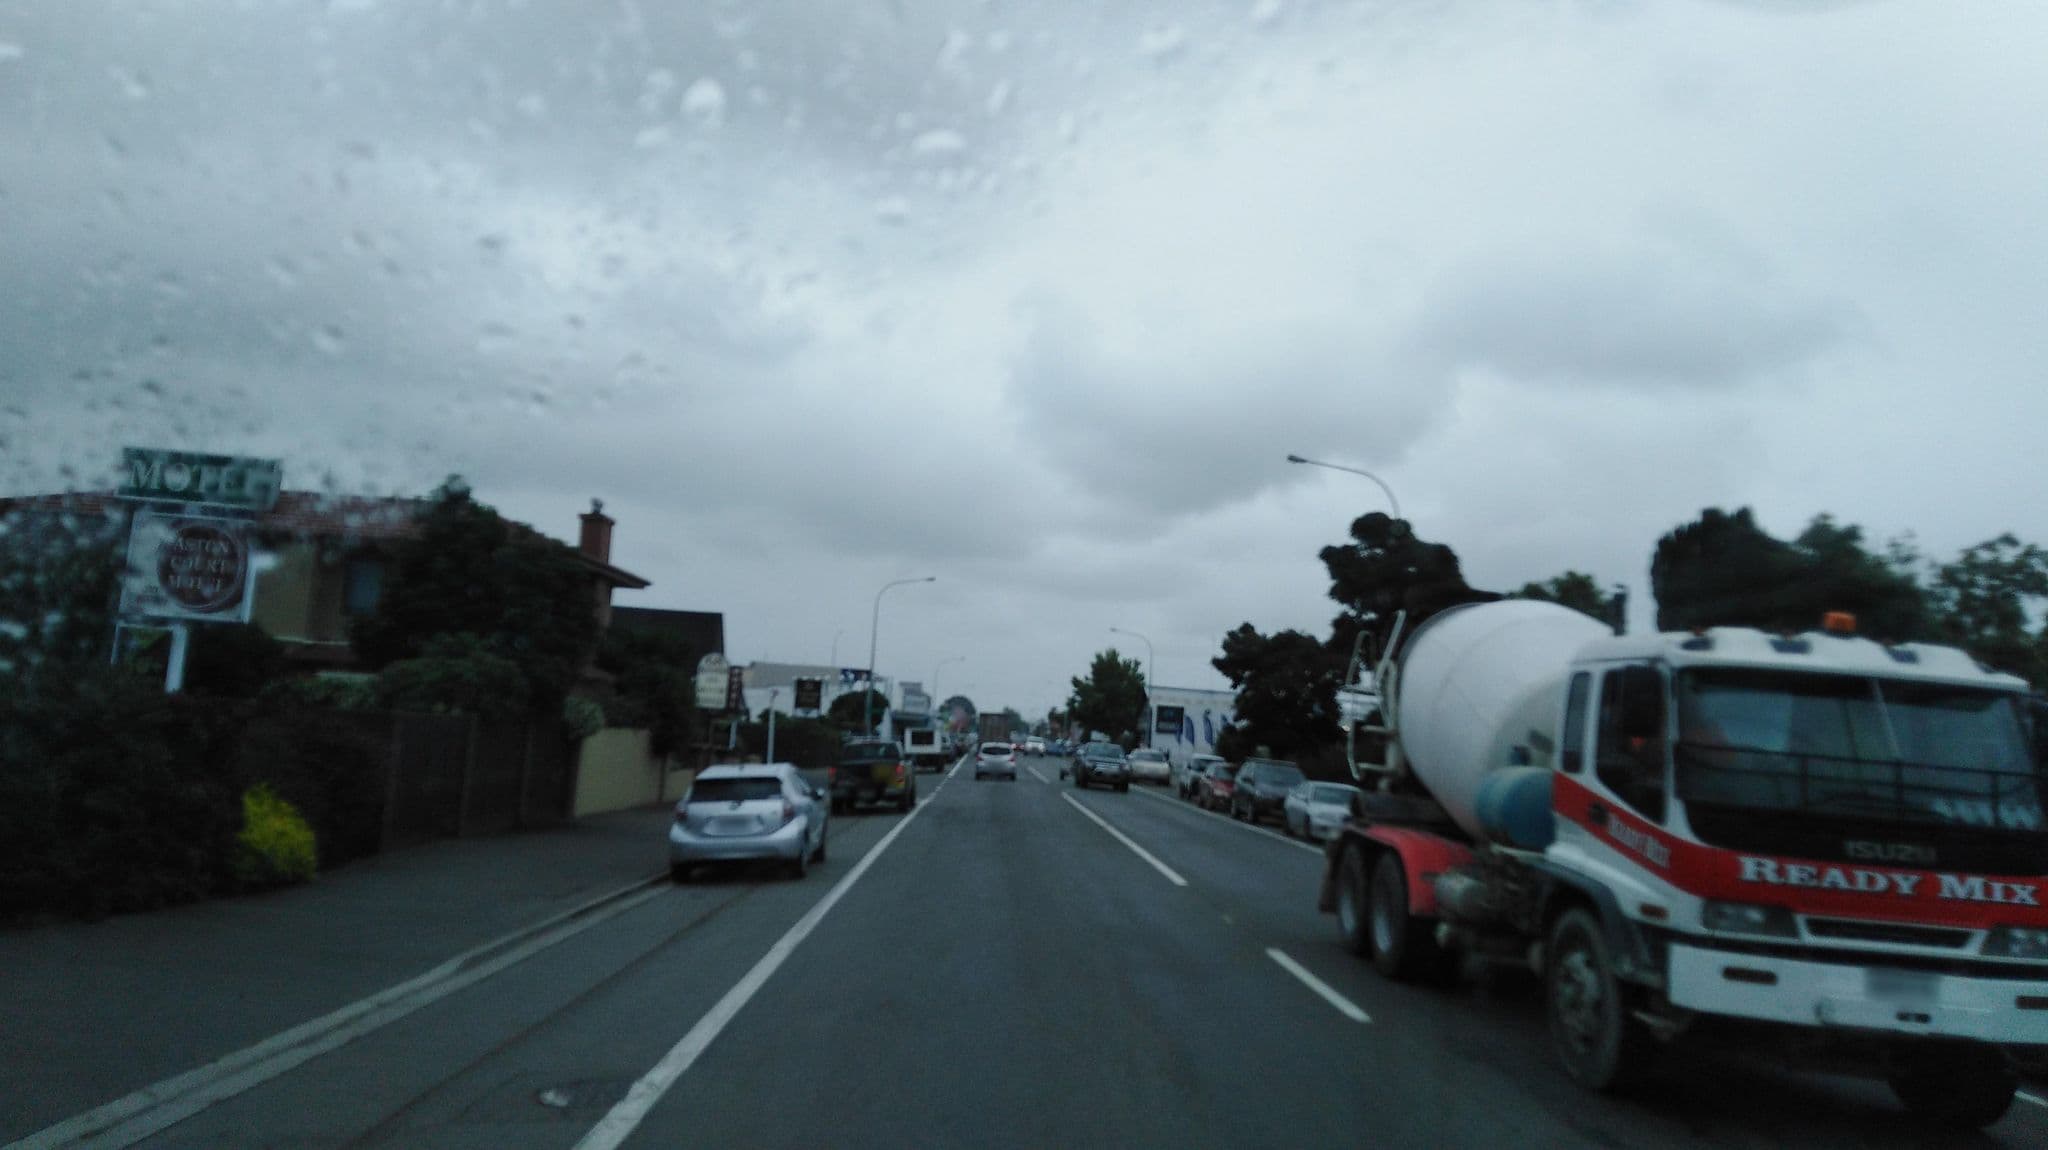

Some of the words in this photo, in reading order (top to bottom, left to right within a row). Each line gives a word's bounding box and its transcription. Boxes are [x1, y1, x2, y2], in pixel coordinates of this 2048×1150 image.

[1843, 840, 1937, 863] ISUZU
[1737, 856, 1921, 897] READY
[1936, 872, 2041, 907] MIX
